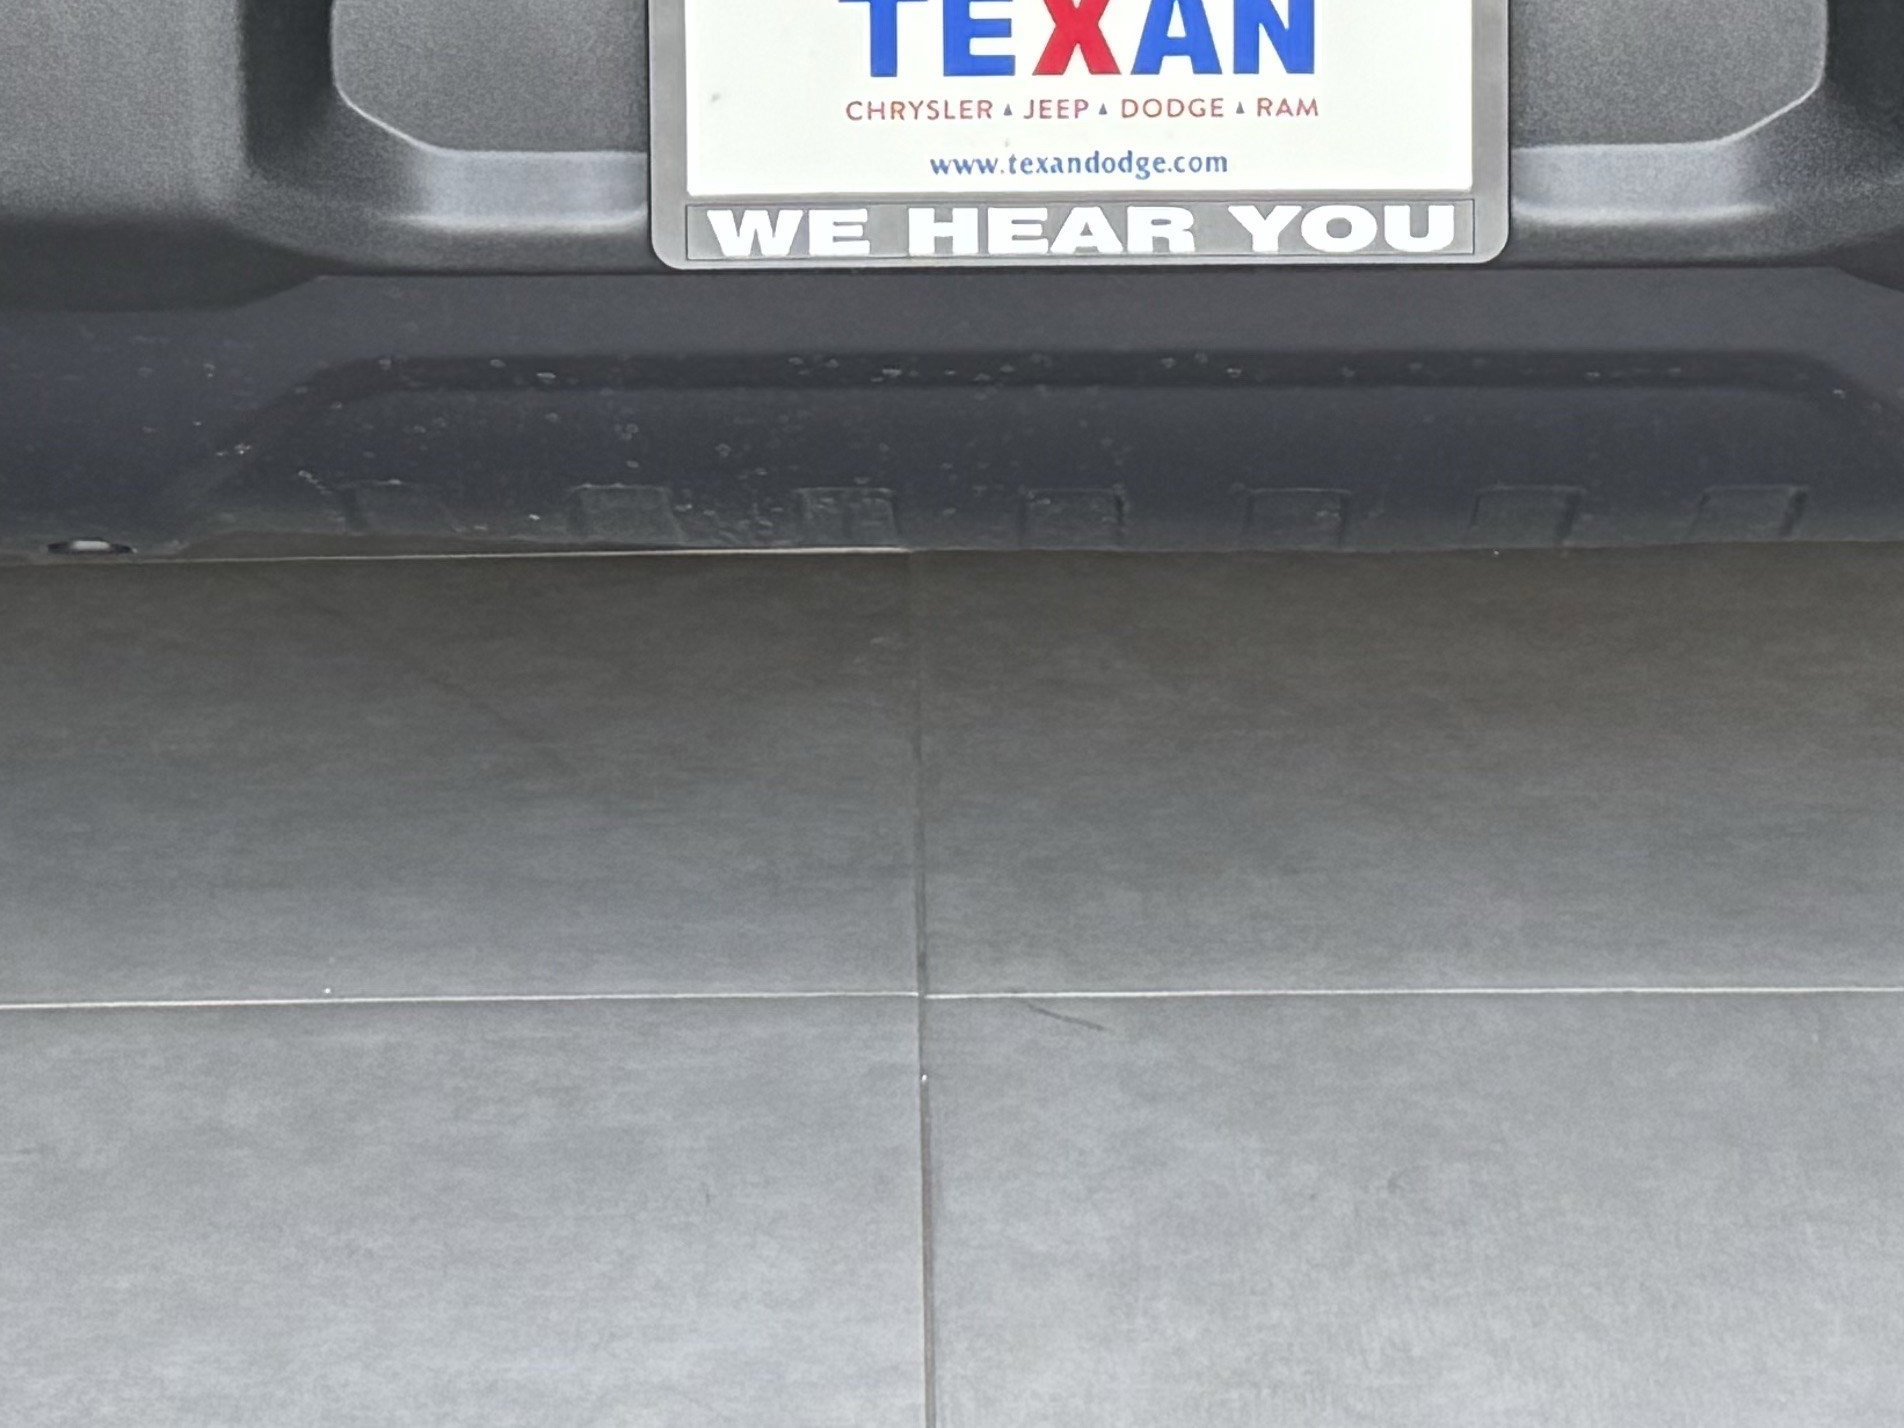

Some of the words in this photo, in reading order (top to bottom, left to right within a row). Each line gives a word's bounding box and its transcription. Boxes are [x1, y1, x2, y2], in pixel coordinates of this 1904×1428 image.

[845, 100, 993, 121] CHRYSLER
[1023, 98, 1090, 120] JEEP
[1121, 97, 1225, 119] DODGE
[1256, 97, 1320, 118] RAM
[929, 149, 1229, 180] www.texandodge.com
[705, 208, 871, 258] WE
[907, 206, 1197, 256] HEAR
[1228, 204, 1457, 255] YOU
